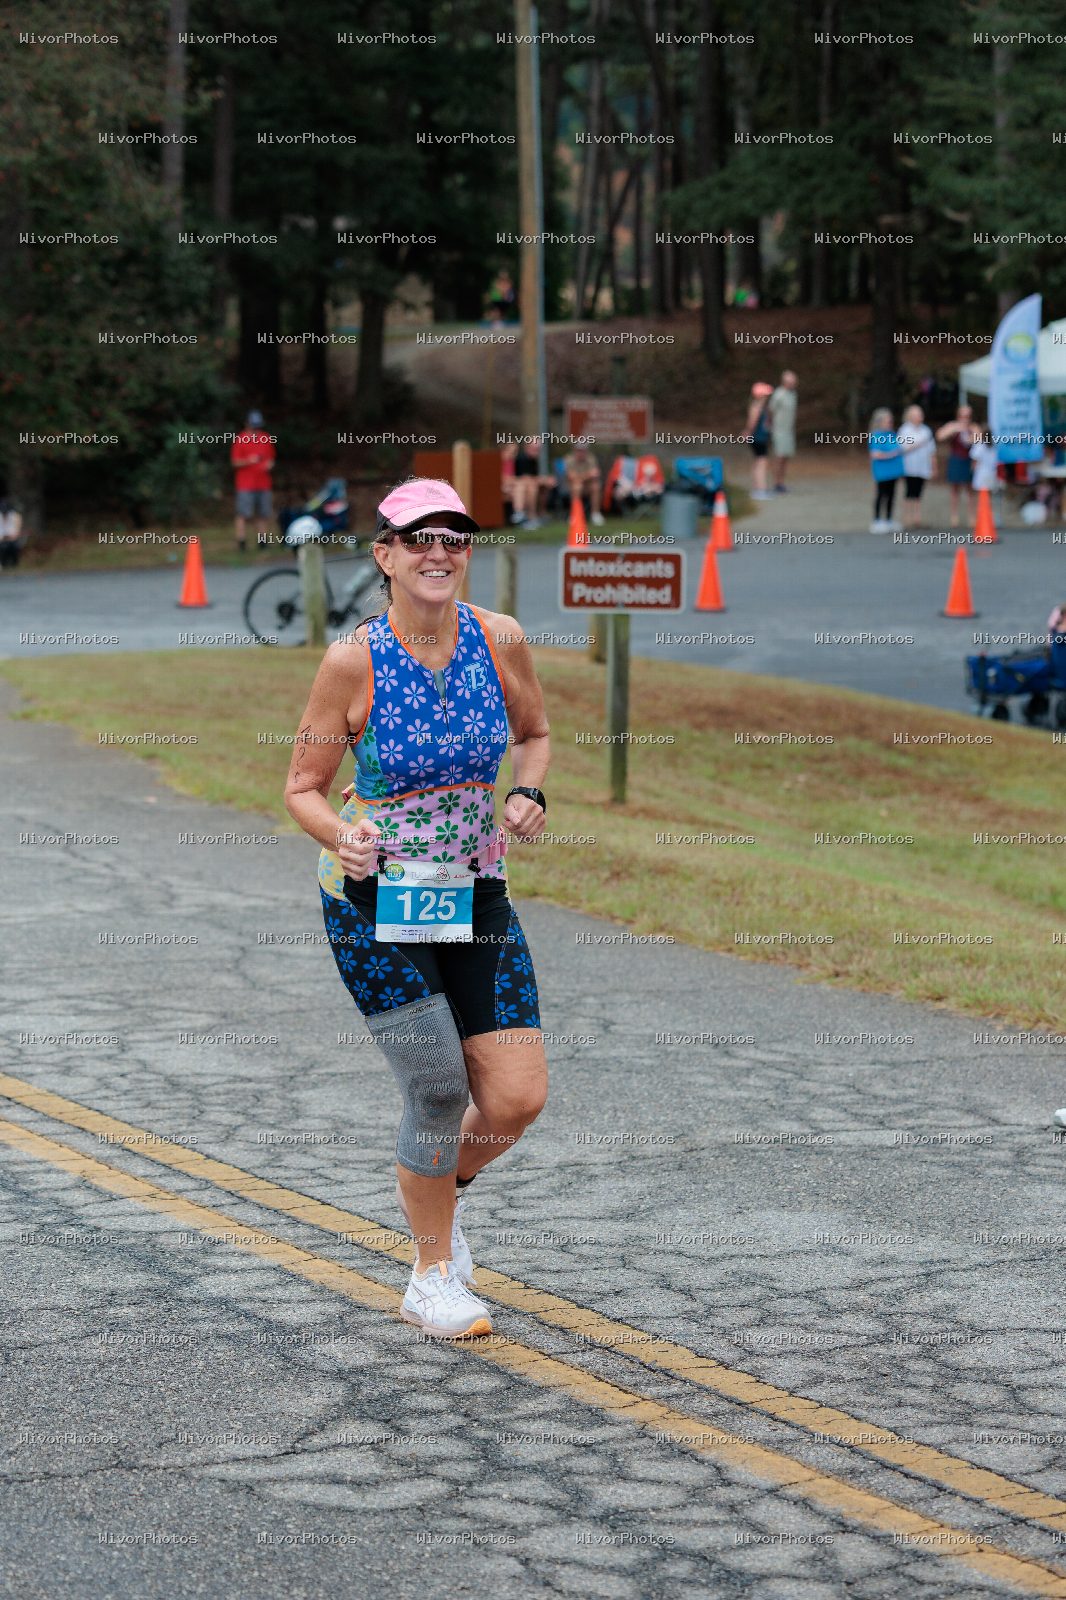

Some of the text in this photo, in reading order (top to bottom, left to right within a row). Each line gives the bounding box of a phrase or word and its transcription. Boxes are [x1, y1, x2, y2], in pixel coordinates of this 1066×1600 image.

[570, 557, 675, 578] Intoxicants
[572, 583, 672, 605] Prohibited
[465, 663, 487, 690] T3
[396, 890, 457, 921] 125
